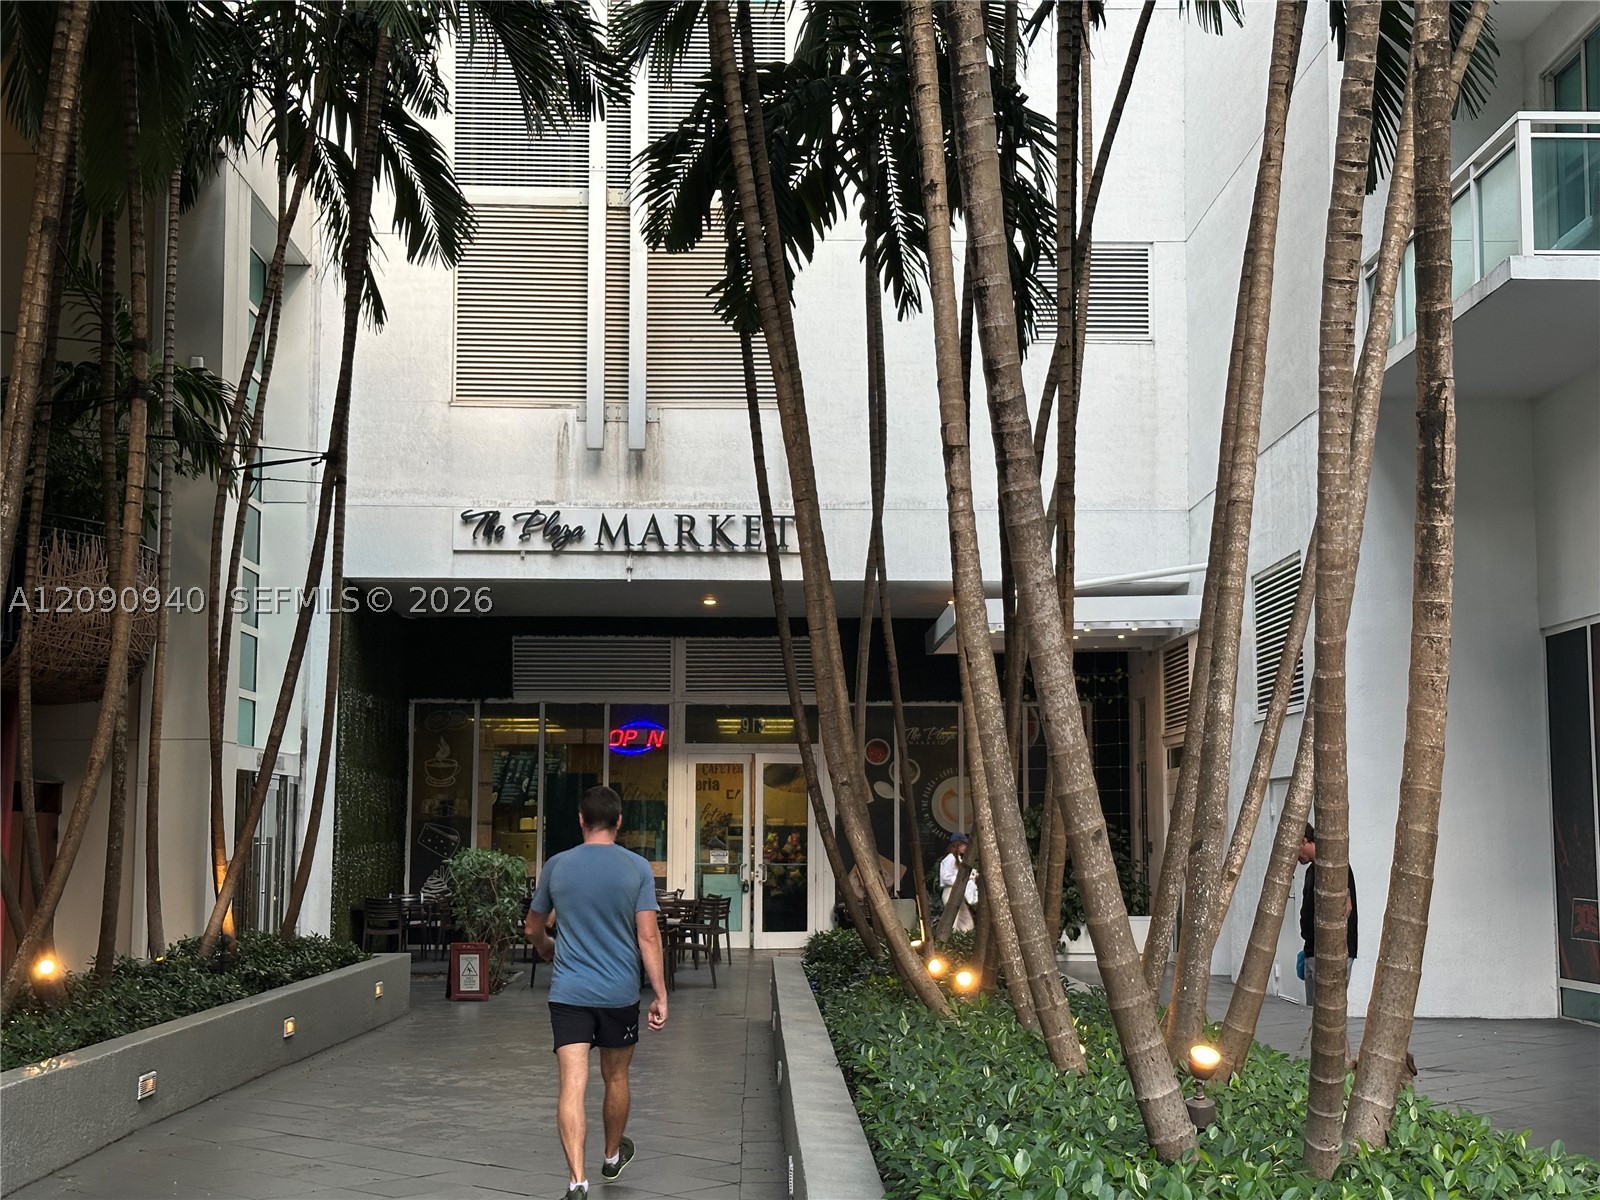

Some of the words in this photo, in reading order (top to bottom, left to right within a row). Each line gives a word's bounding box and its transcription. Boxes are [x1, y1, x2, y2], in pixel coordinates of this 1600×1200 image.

[460, 509, 505, 544] The
[512, 509, 587, 550] Plaza
[594, 513, 796, 550] MARKET
